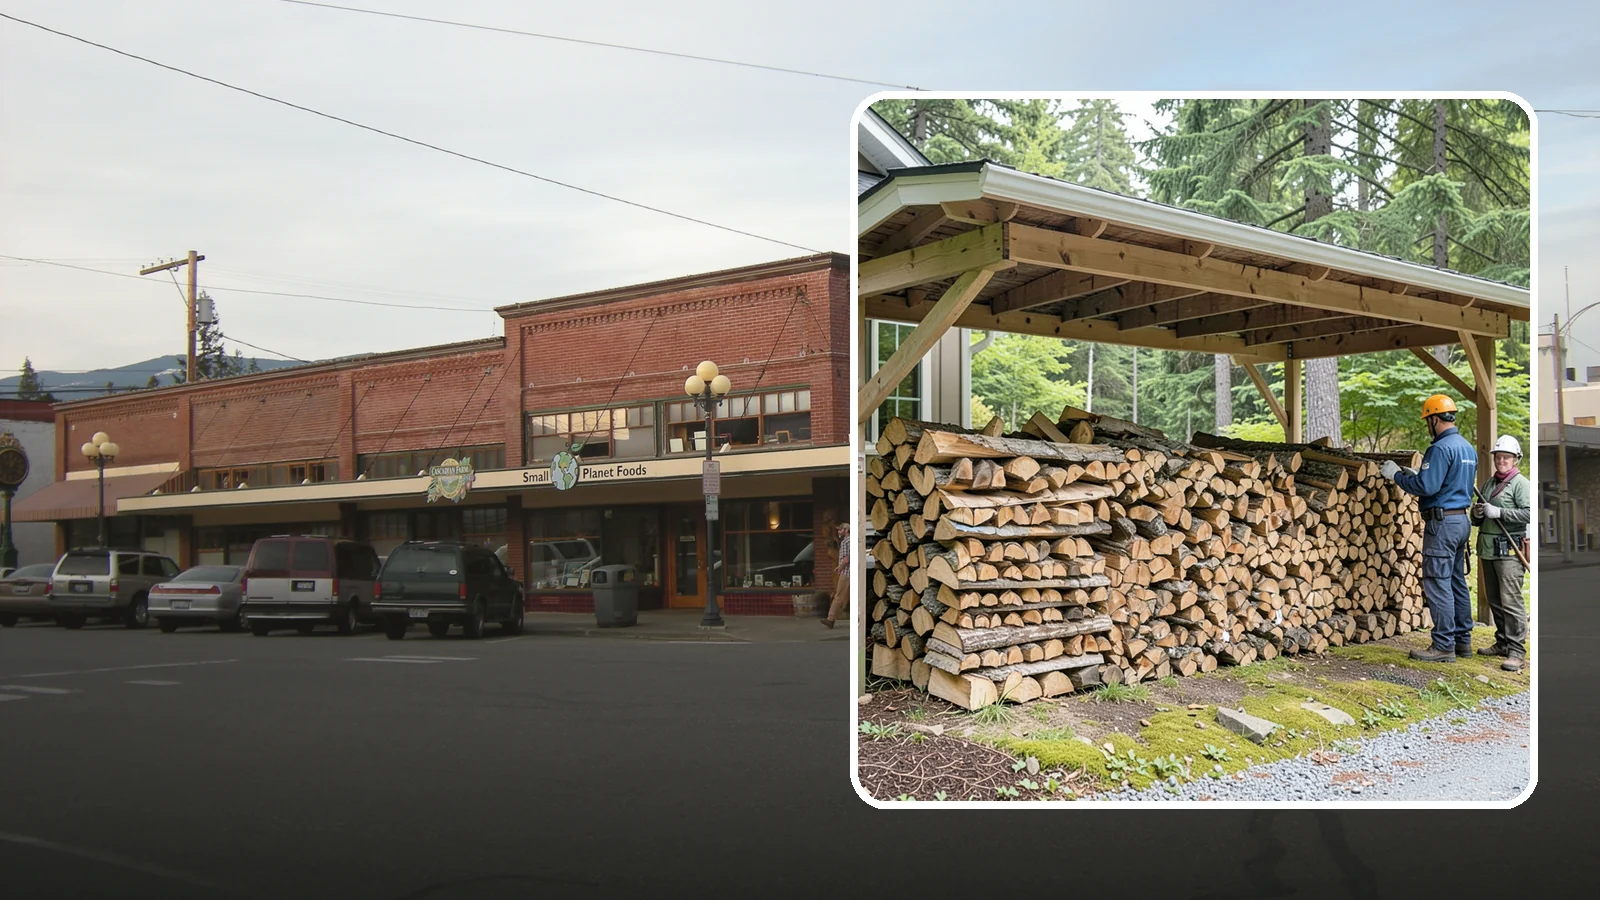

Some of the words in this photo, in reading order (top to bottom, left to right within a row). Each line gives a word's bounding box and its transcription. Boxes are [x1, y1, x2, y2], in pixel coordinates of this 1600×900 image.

[523, 471, 549, 483] Small
[583, 468, 614, 479] Planet
[617, 464, 647, 477] Foods
